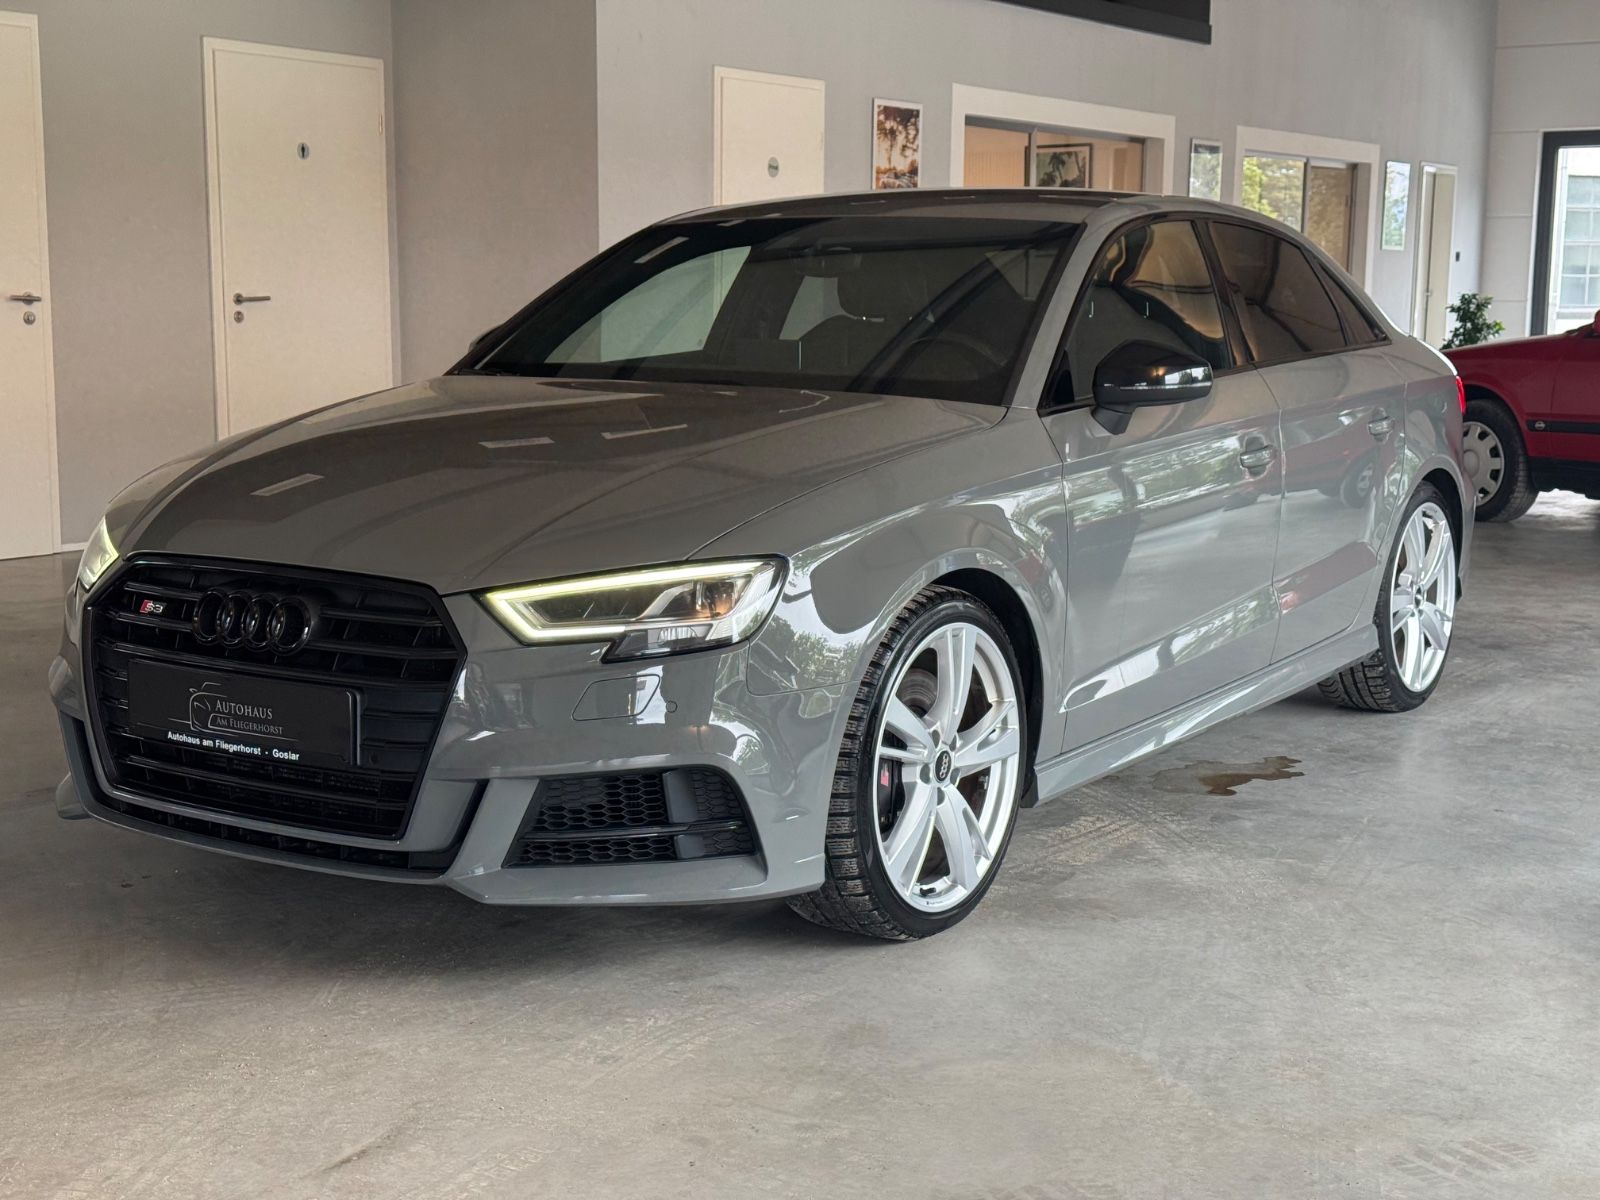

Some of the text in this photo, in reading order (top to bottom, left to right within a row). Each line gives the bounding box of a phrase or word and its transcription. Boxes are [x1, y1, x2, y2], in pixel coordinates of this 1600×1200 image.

[144, 601, 163, 613] S3
[215, 699, 273, 720] AUTOHAUS
[216, 717, 283, 735] AM FLIEGERHORST
[167, 731, 300, 761] Autohaus am Fliegerhorst Goslar
